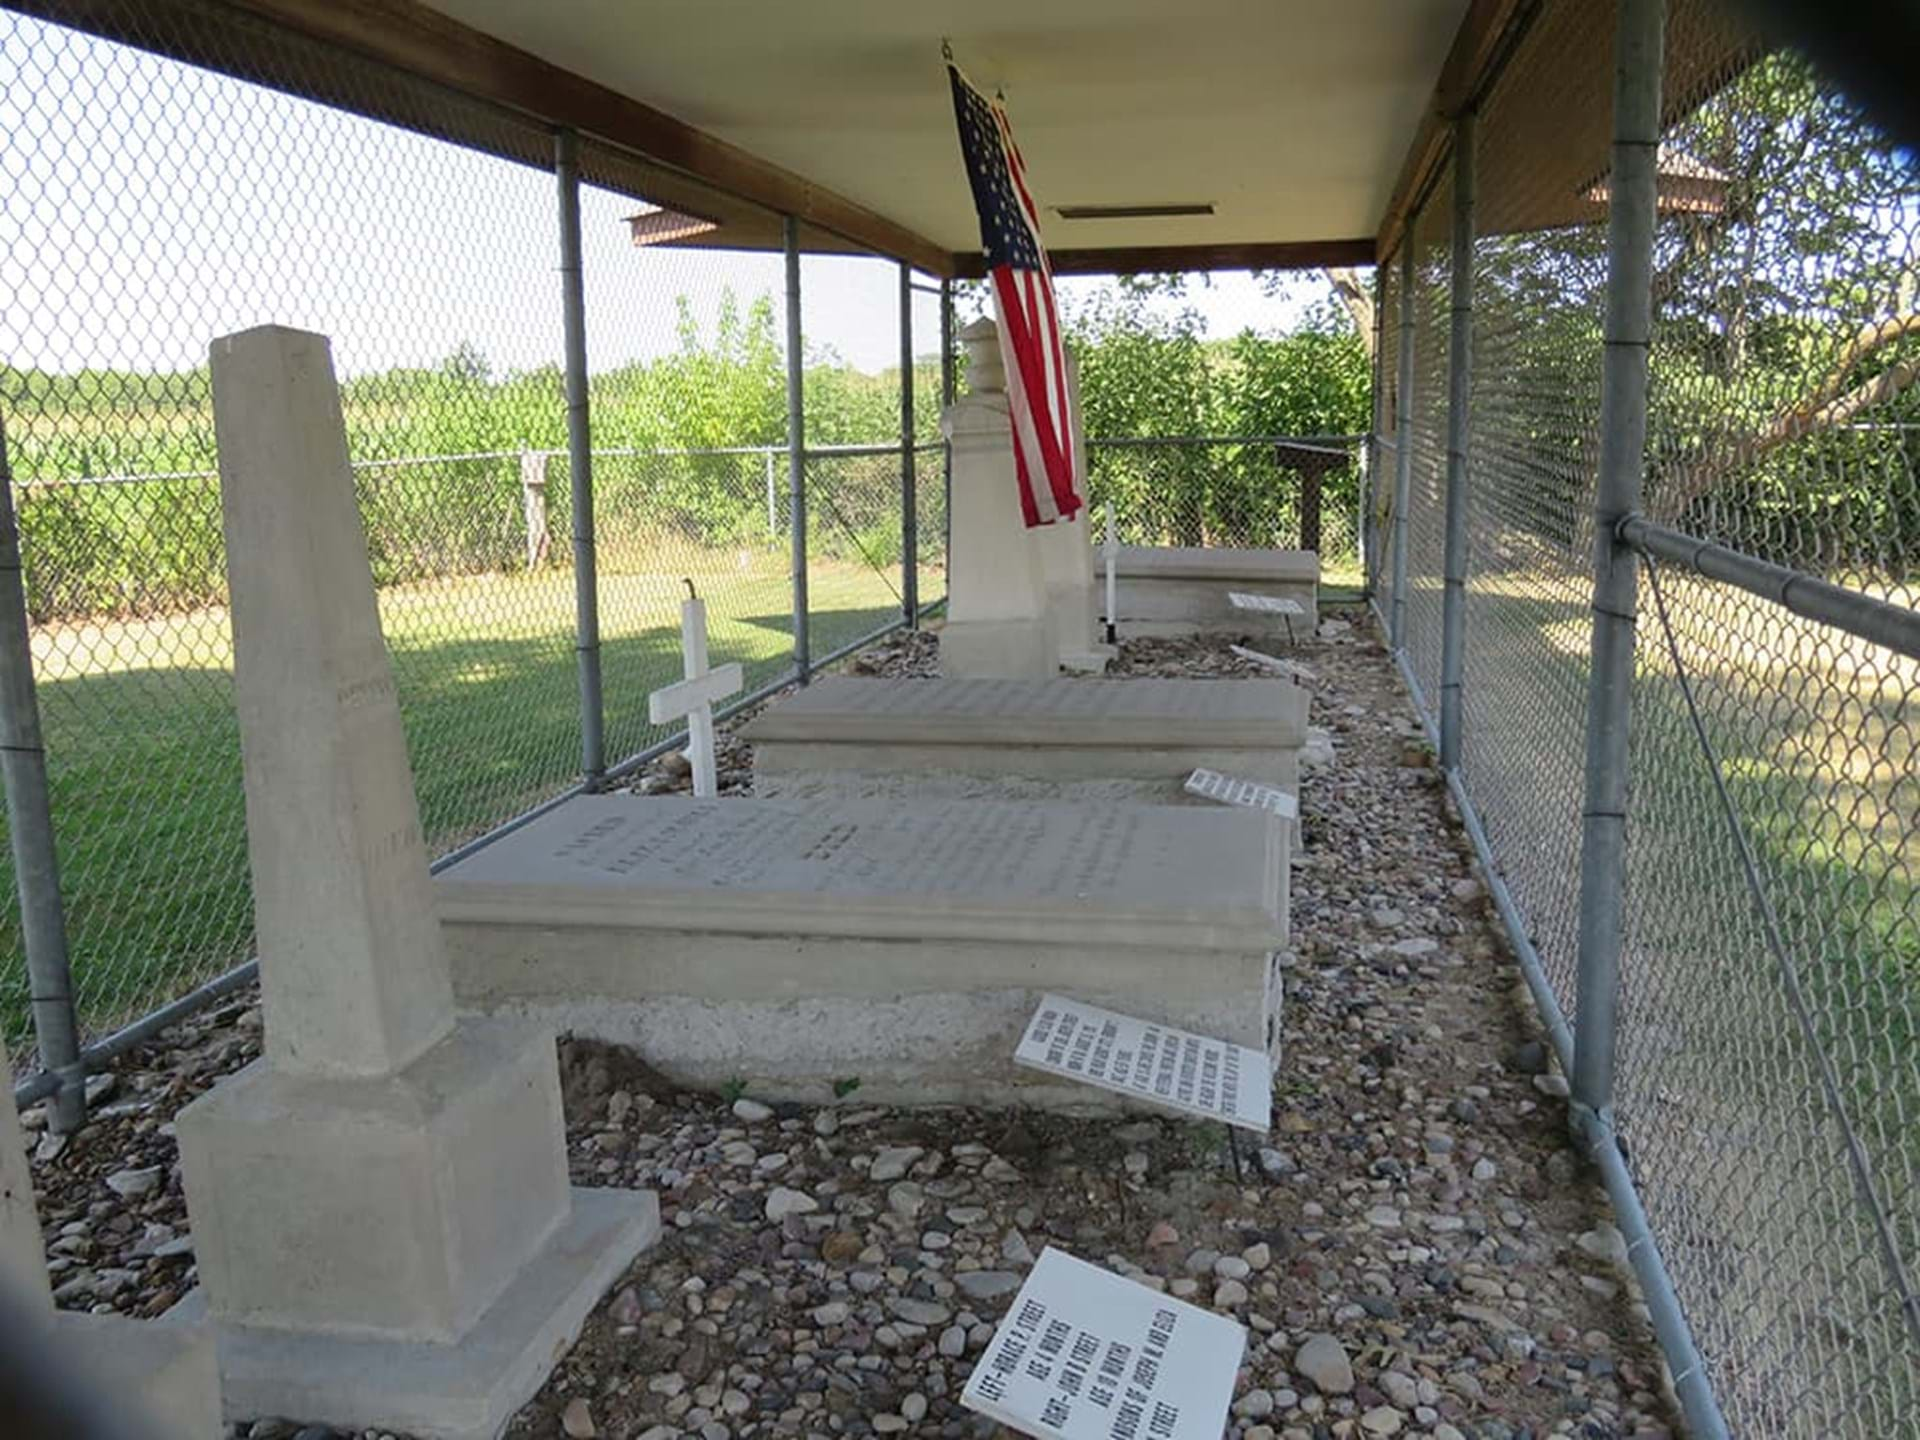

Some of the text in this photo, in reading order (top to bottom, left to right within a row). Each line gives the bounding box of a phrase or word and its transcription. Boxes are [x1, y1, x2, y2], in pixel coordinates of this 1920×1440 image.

[1015, 1299, 1046, 1332] STREET
[1038, 1319, 1072, 1355] MONTHS
[1070, 1331, 1100, 1365] STREET
[1147, 1328, 1170, 1348] AND
[1026, 1359, 1051, 1381] AGE
[1100, 1341, 1131, 1378] MONTHS
[1132, 1355, 1158, 1391] JOSEPH
[1088, 1385, 1114, 1408] AGE
[1125, 1386, 1147, 1403] OF
[1148, 1401, 1179, 1437] STREET
